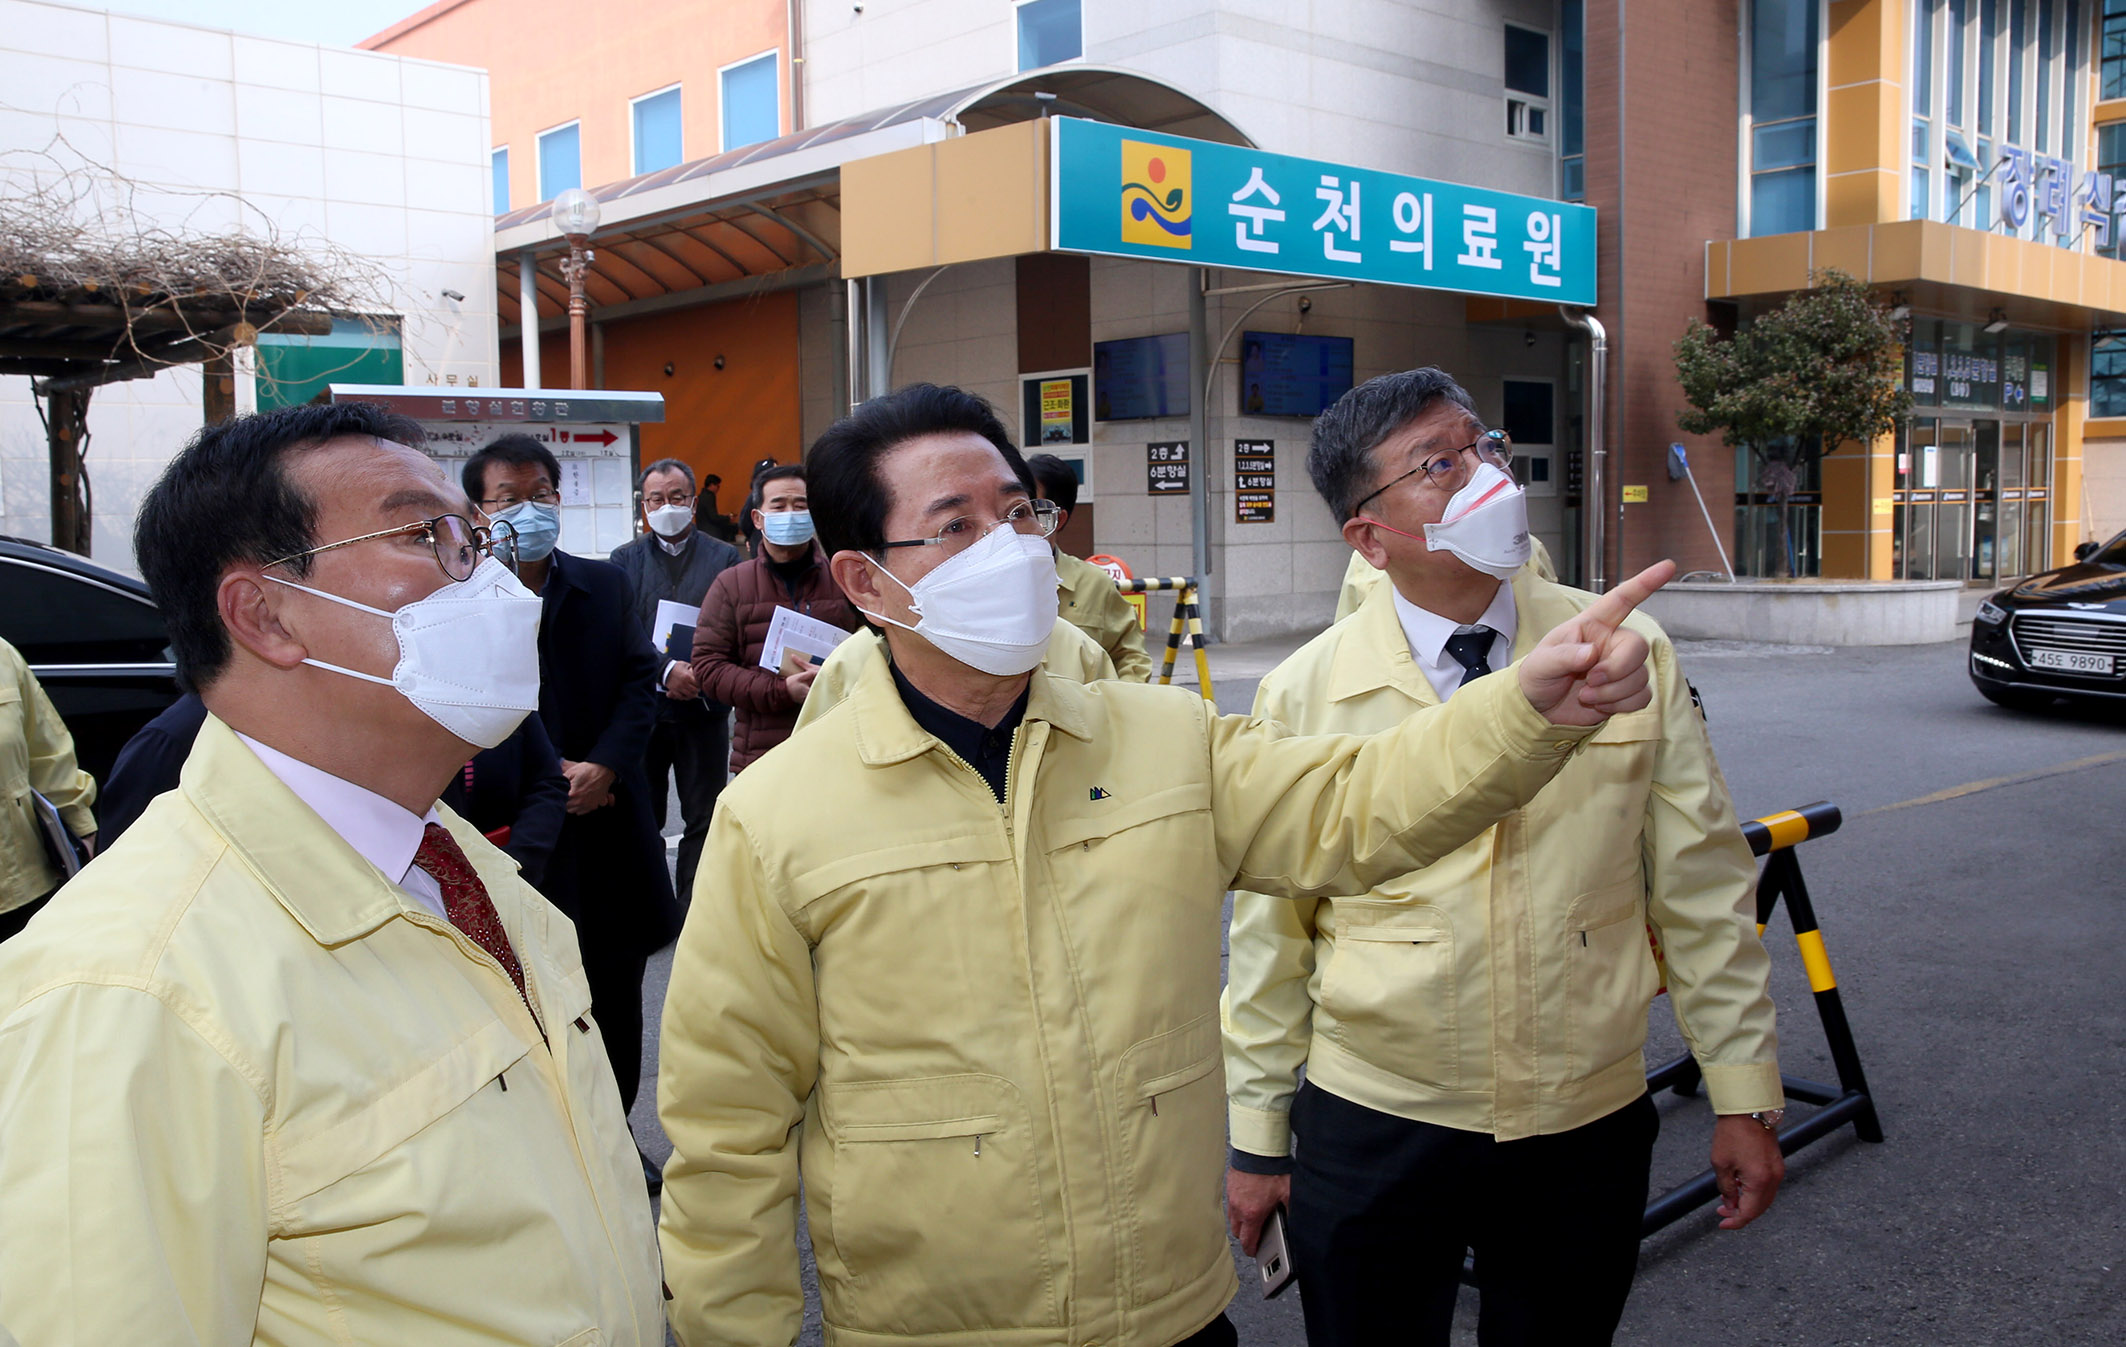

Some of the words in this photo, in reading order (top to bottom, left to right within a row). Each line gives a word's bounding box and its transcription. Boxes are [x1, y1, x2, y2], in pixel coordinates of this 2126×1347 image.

[1998, 144, 2126, 248] 장례식
[1228, 166, 1561, 287] 순천의료원
[426, 374, 478, 388] 사무실
[1151, 447, 1168, 460] 2층
[1150, 465, 1186, 478] 6분향실
[1247, 477, 1272, 487] 6분향실
[2070, 655, 2105, 670] 9890
